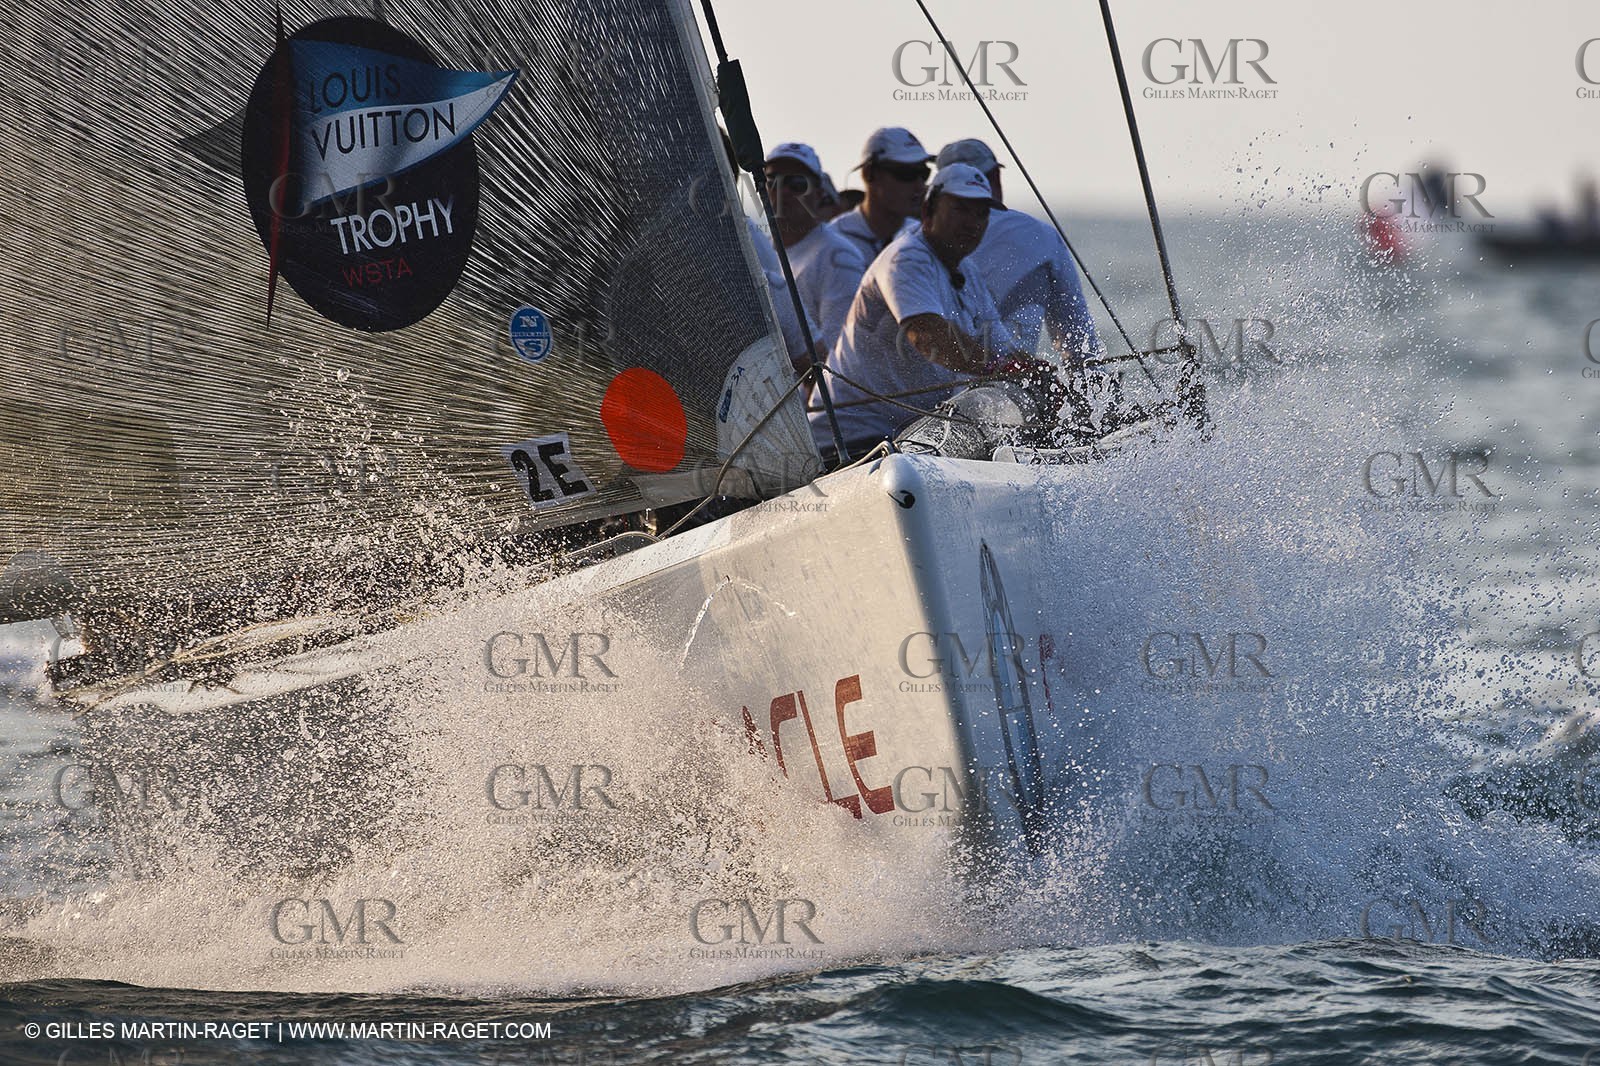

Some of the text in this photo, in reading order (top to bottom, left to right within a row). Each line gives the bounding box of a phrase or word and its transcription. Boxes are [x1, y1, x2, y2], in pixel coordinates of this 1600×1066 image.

[309, 64, 401, 114] LOUIS
[311, 103, 456, 161] VUITTON
[330, 195, 454, 255] TROPHY
[342, 257, 413, 288] WSTA
[511, 441, 589, 502] 2E
